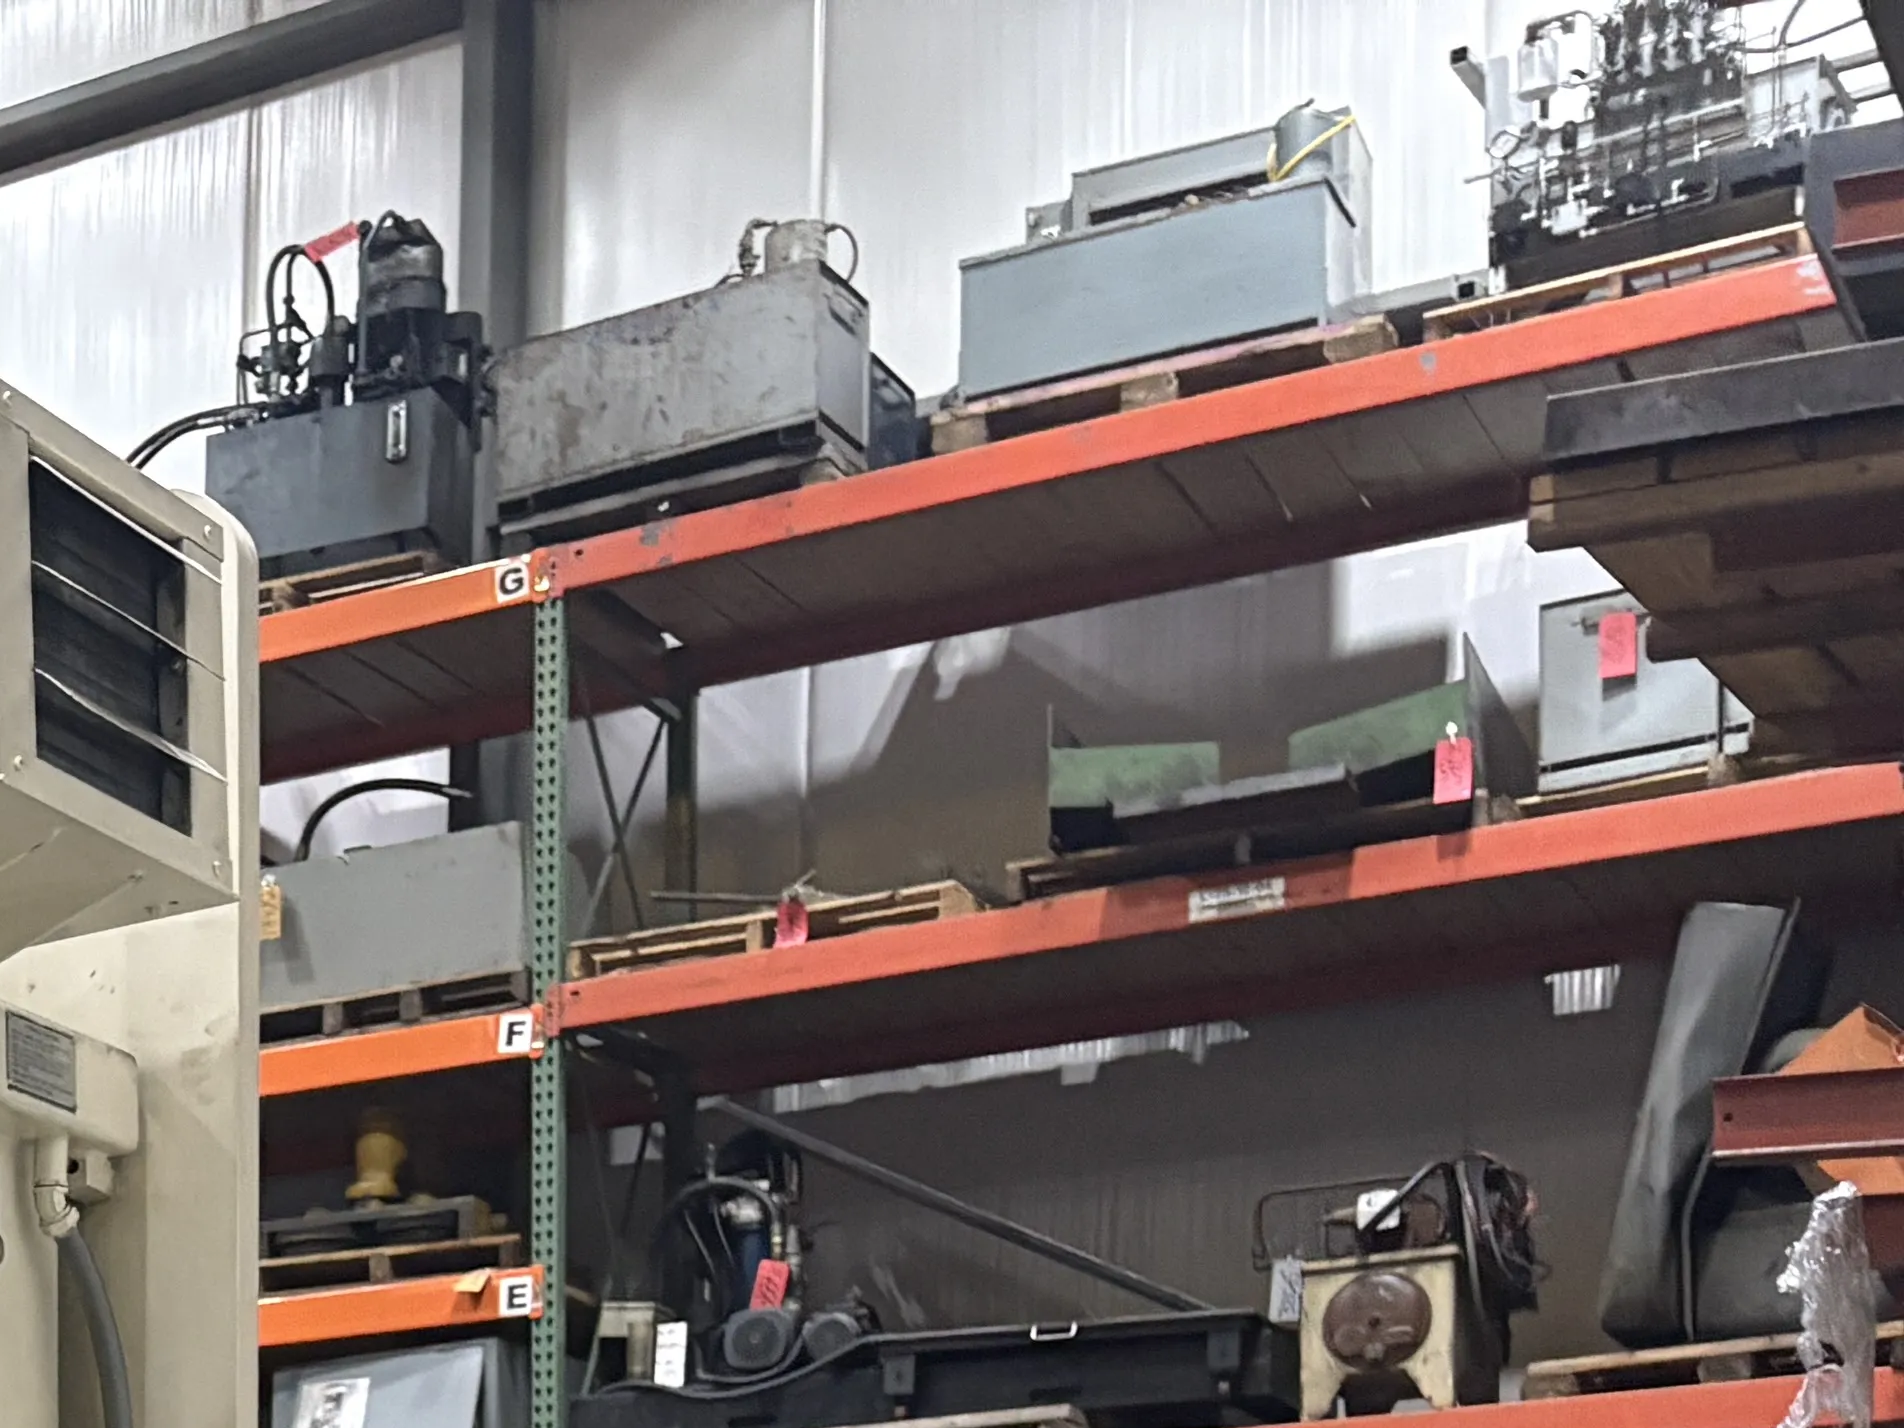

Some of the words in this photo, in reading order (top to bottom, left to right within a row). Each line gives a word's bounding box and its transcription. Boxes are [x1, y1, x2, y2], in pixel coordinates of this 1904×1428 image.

[499, 567, 524, 596] G
[505, 1021, 527, 1047] F
[507, 1283, 528, 1311] E
